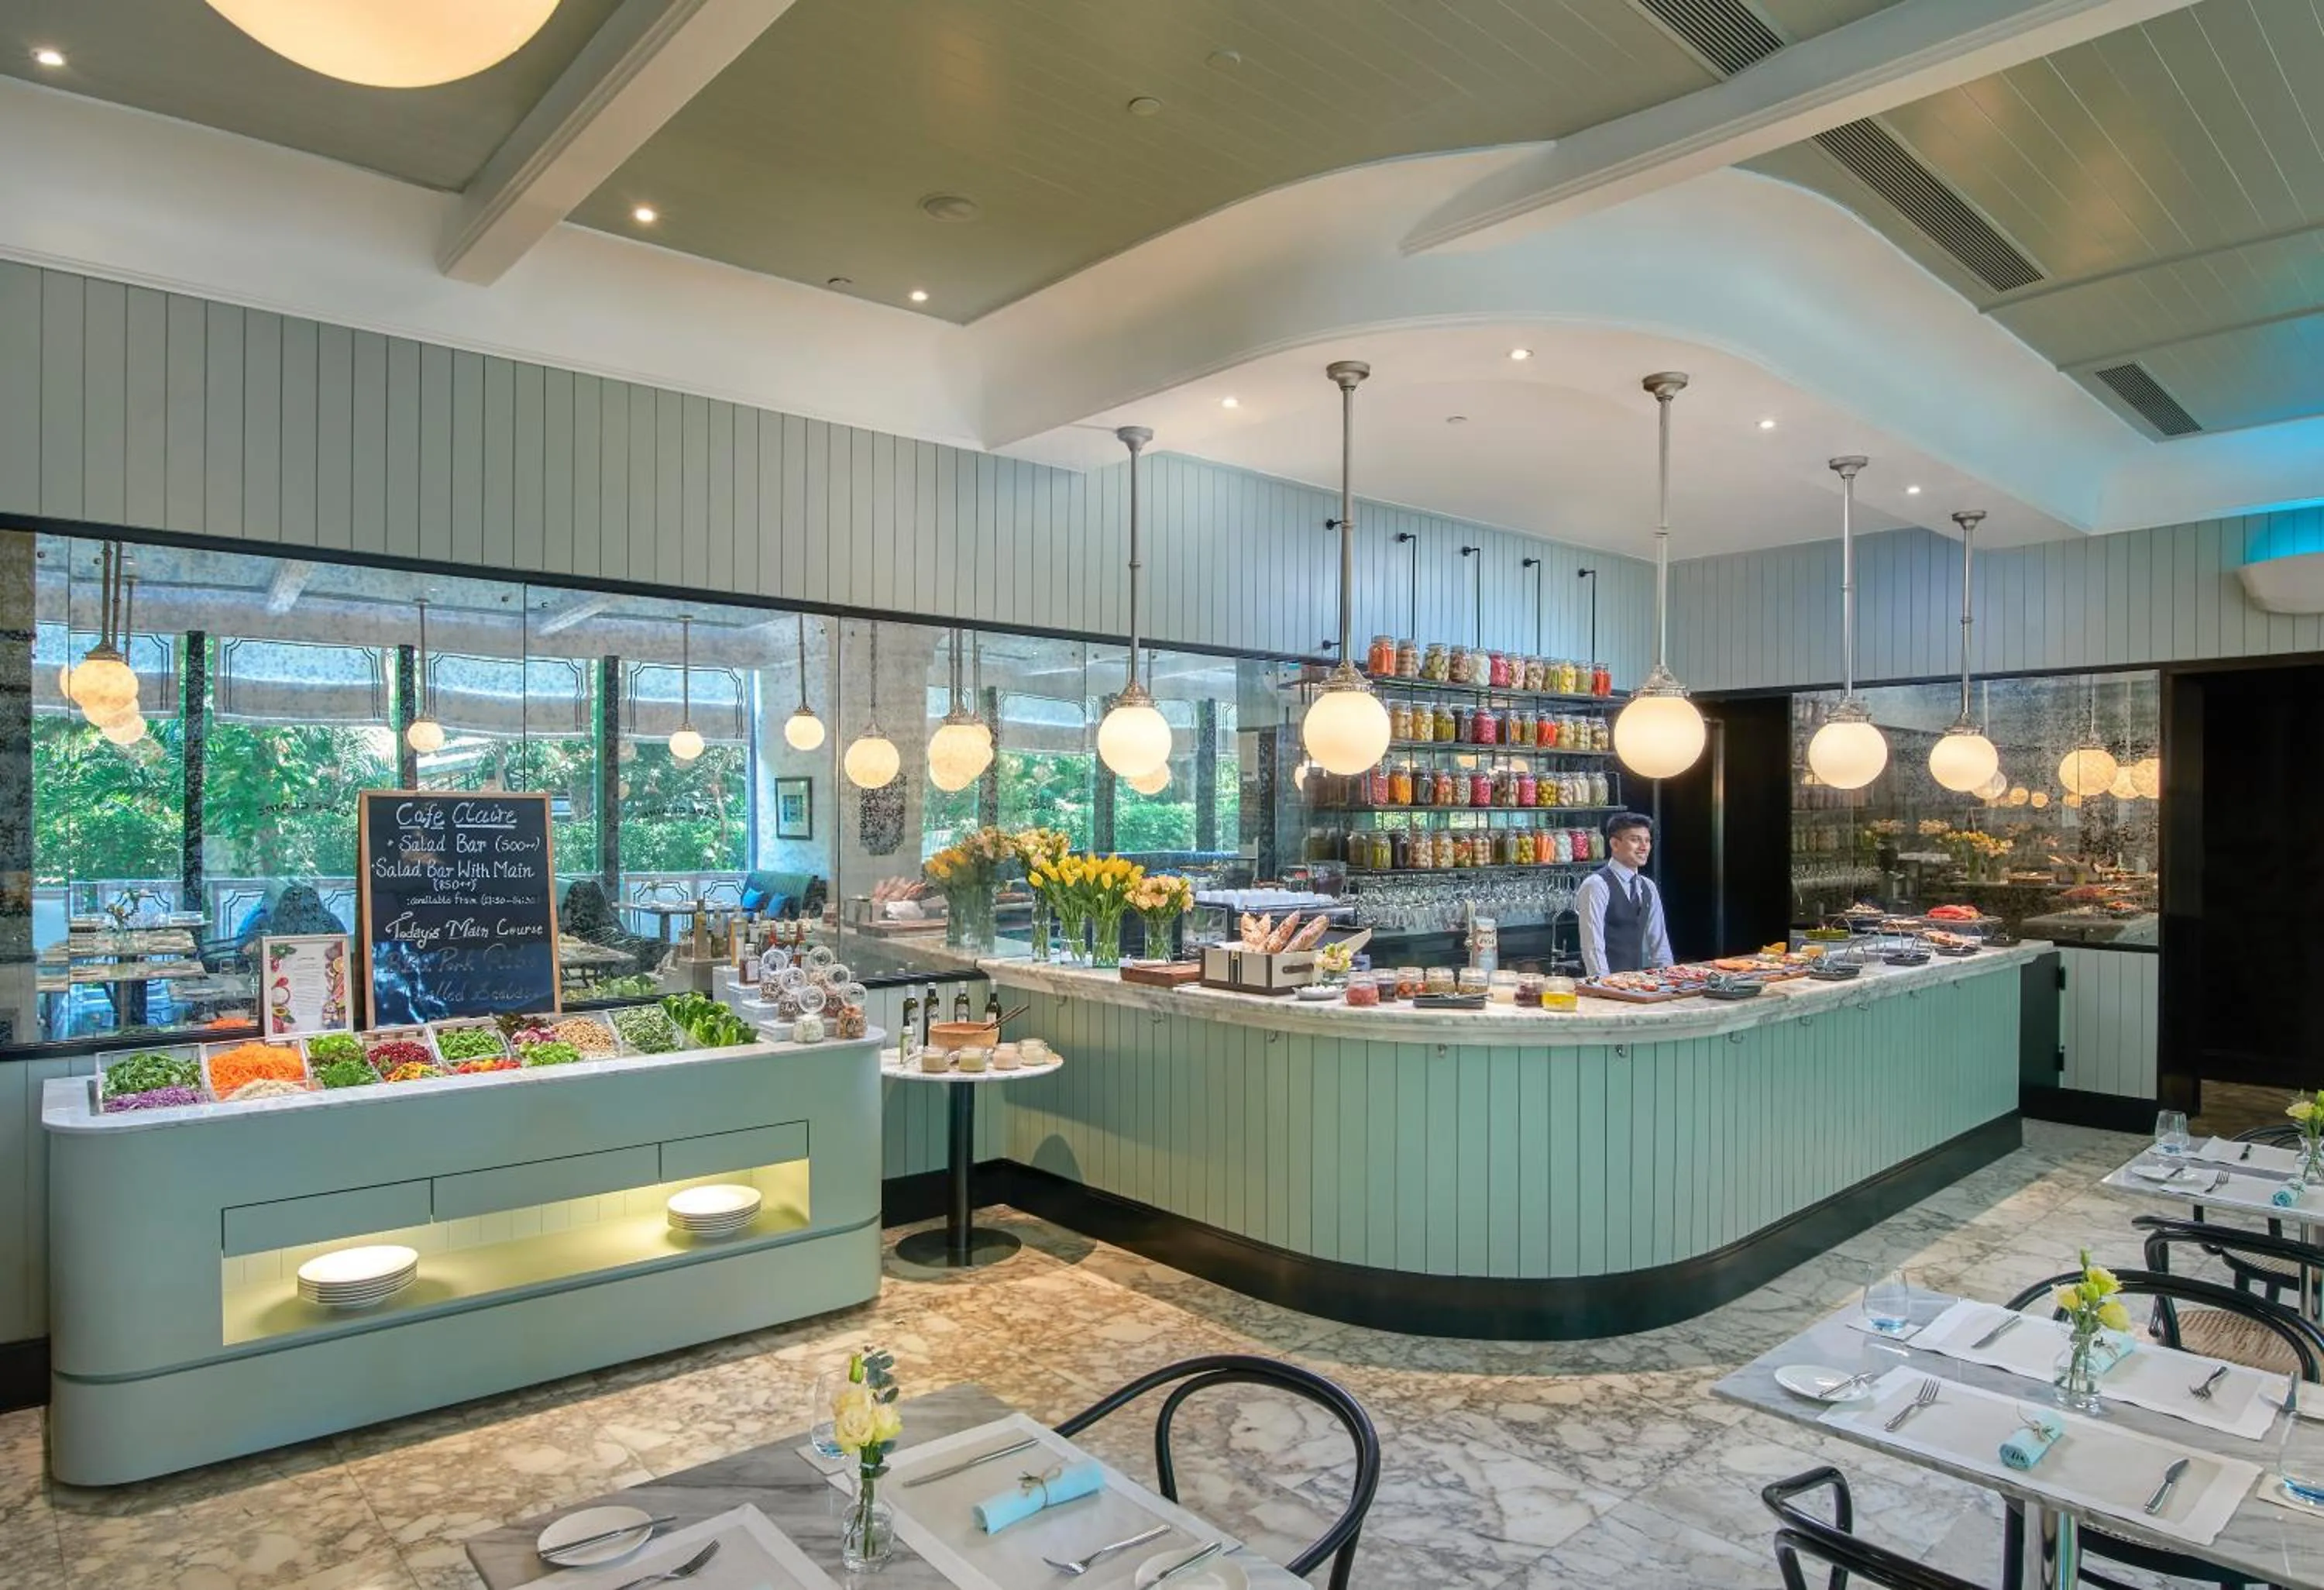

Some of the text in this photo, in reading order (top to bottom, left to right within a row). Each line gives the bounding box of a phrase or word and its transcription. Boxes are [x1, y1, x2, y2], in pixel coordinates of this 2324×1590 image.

[396, 802, 517, 828] Cafe Claire
[398, 834, 446, 852] Salad
[456, 832, 486, 853] Bar
[376, 856, 535, 879] Salad Bar With Main
[445, 917, 490, 938] Main
